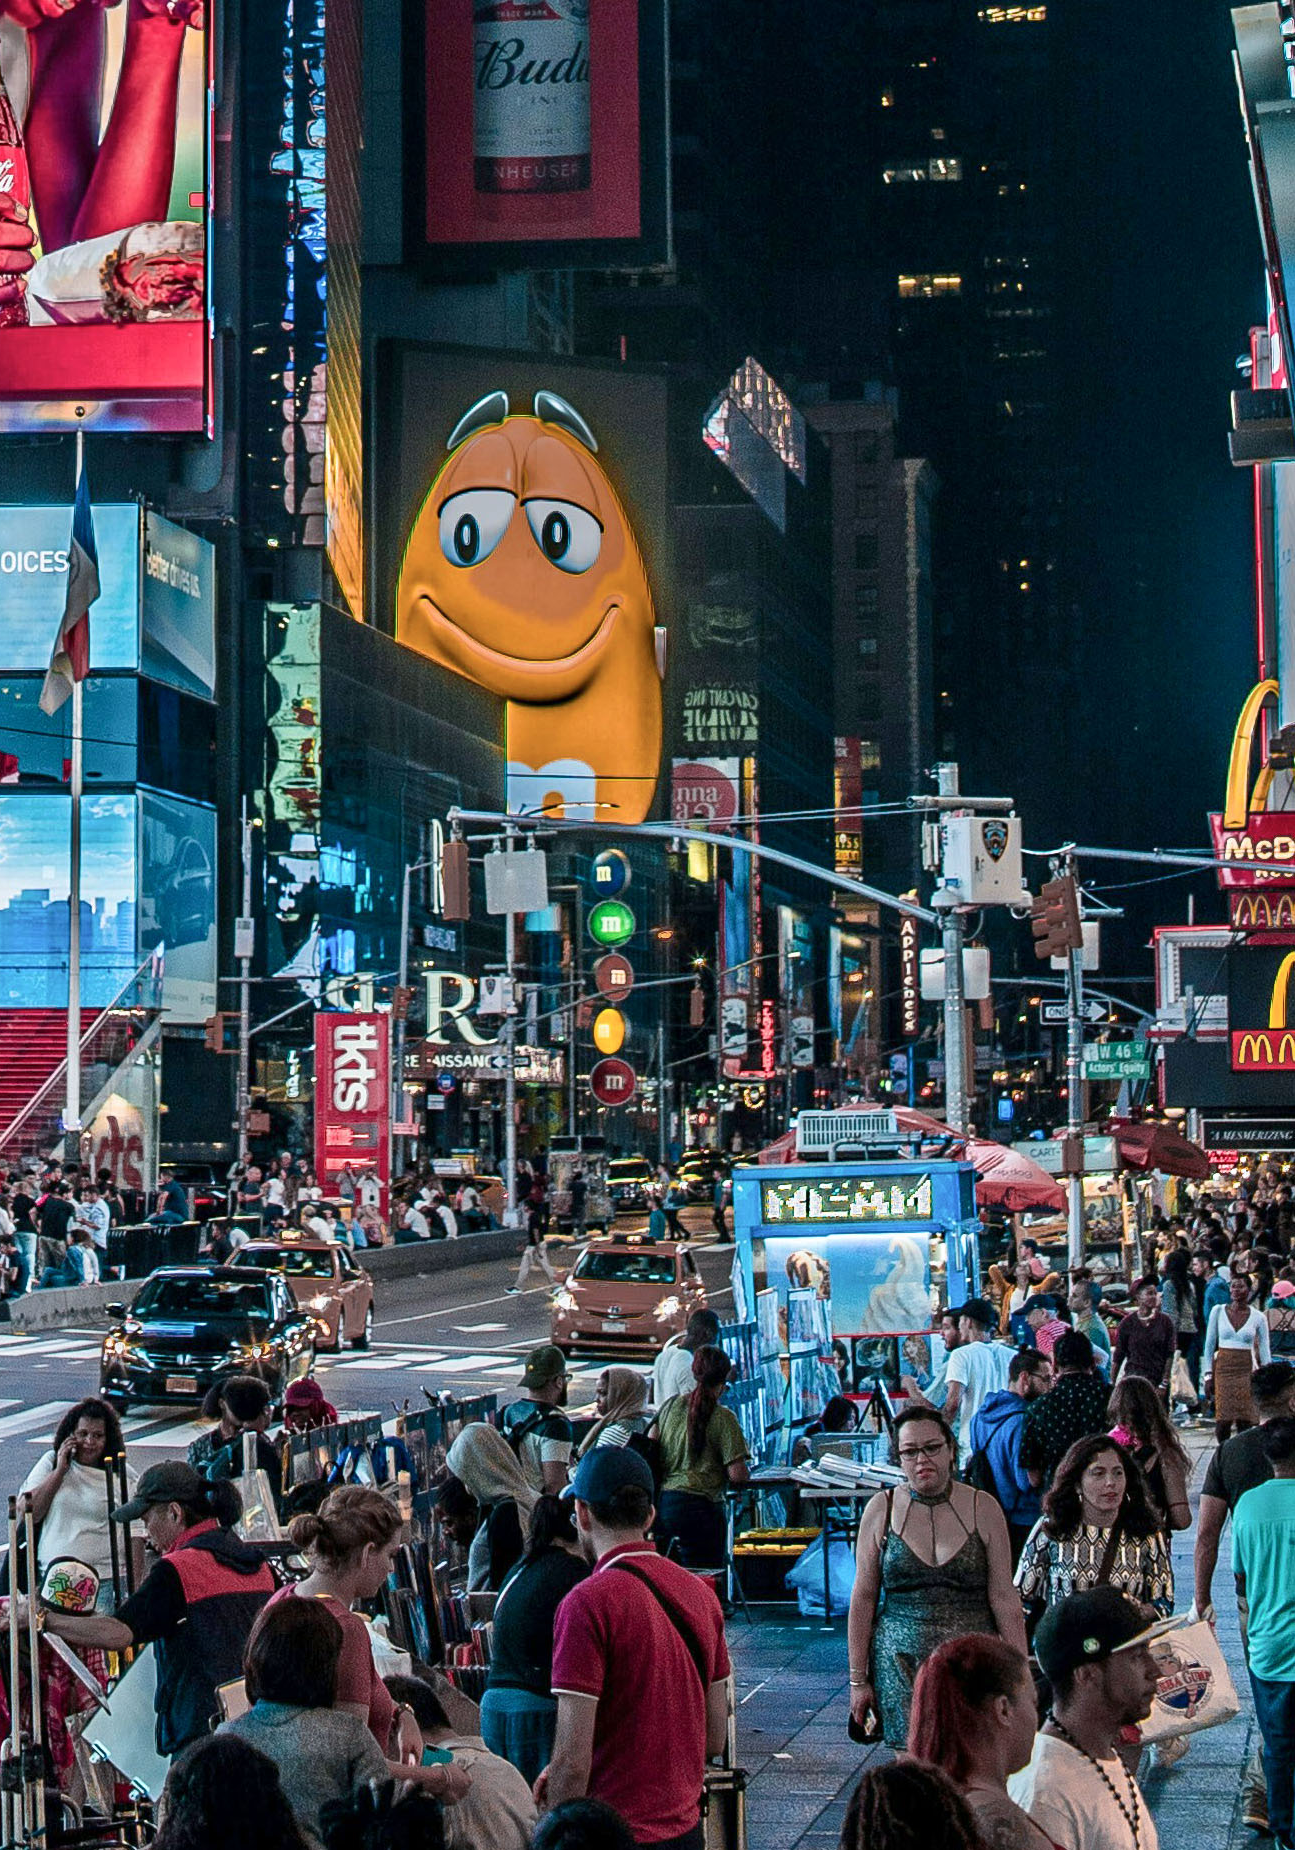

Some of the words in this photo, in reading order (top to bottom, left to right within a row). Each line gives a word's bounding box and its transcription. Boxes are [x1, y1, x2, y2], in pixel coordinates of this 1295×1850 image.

[422, 970, 498, 1045] R
[1099, 1045, 1111, 1060] W
[1115, 1044, 1132, 1059] 46
[333, 1021, 379, 1112] tkts
[1119, 1062, 1145, 1075] Equity
[606, 1074, 624, 1091] m
[1223, 1130, 1294, 1141] MESMERIZING
